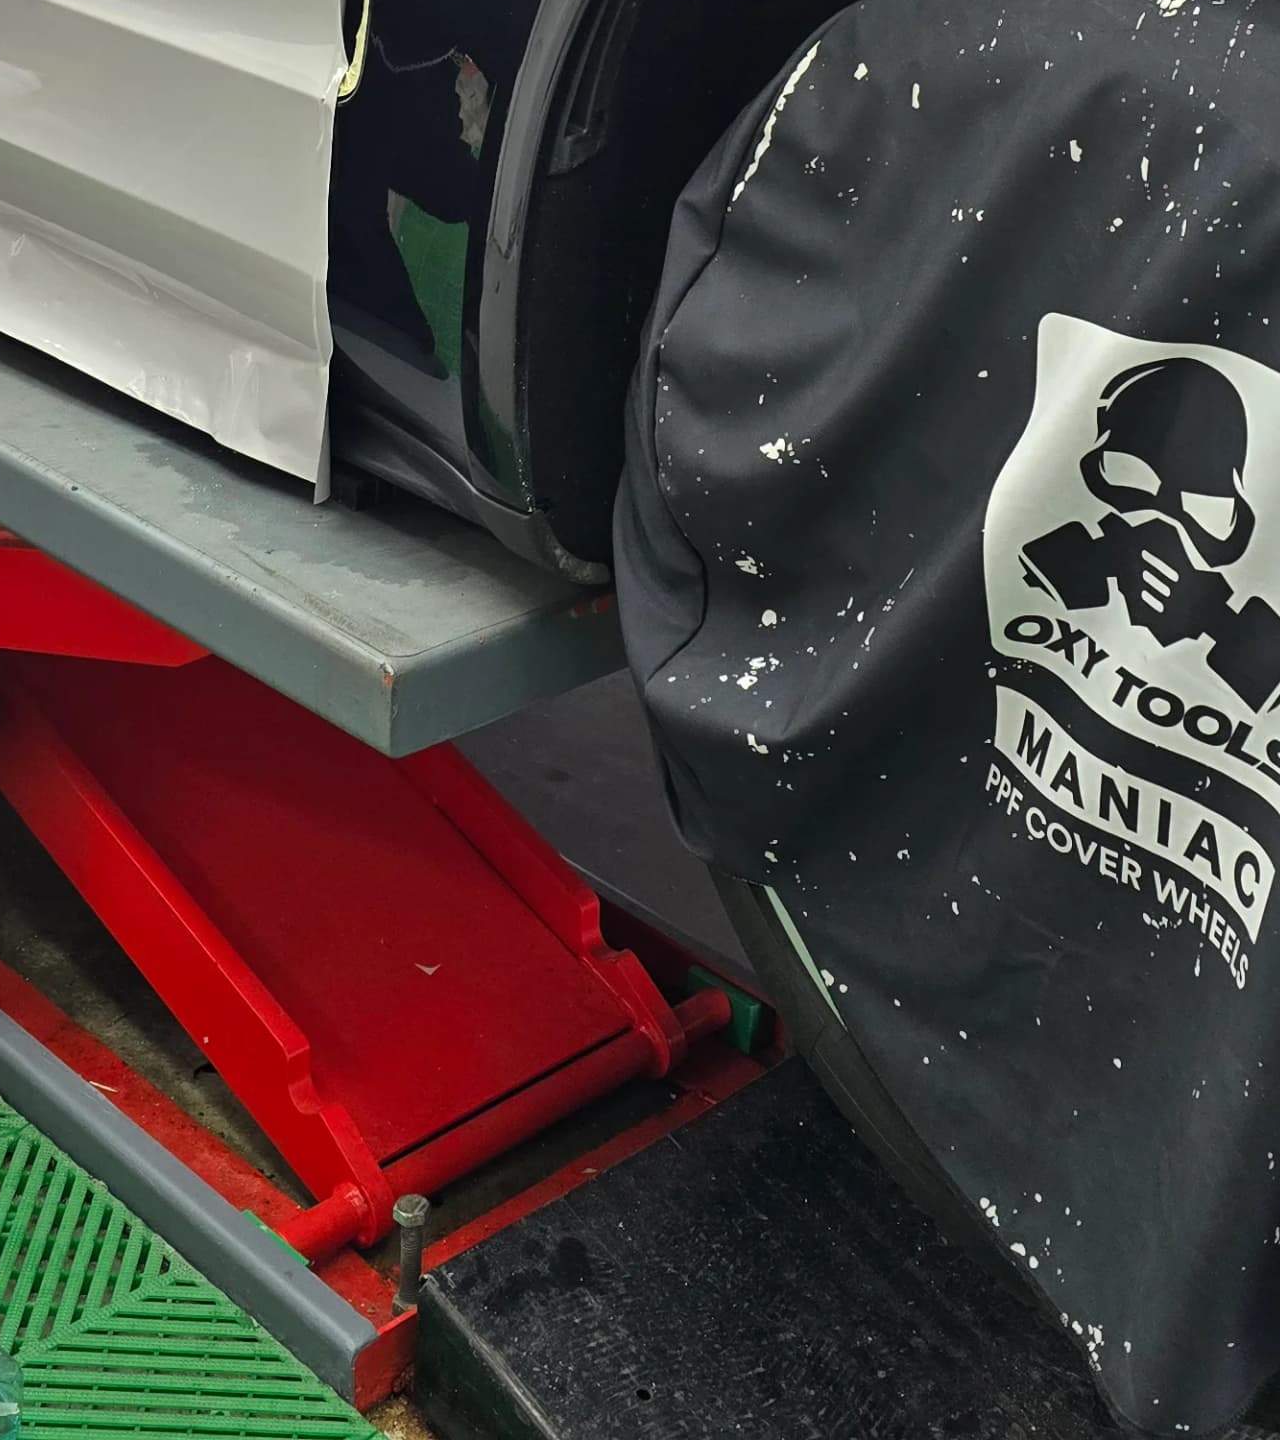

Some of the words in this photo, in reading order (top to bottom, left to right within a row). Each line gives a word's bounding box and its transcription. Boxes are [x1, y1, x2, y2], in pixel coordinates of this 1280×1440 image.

[1003, 615, 1110, 679] OXY
[984, 762, 1024, 816] PPF
[1025, 806, 1142, 892] COVER
[1152, 869, 1249, 990] WHEELS
[1016, 708, 1261, 909] MANIAC
